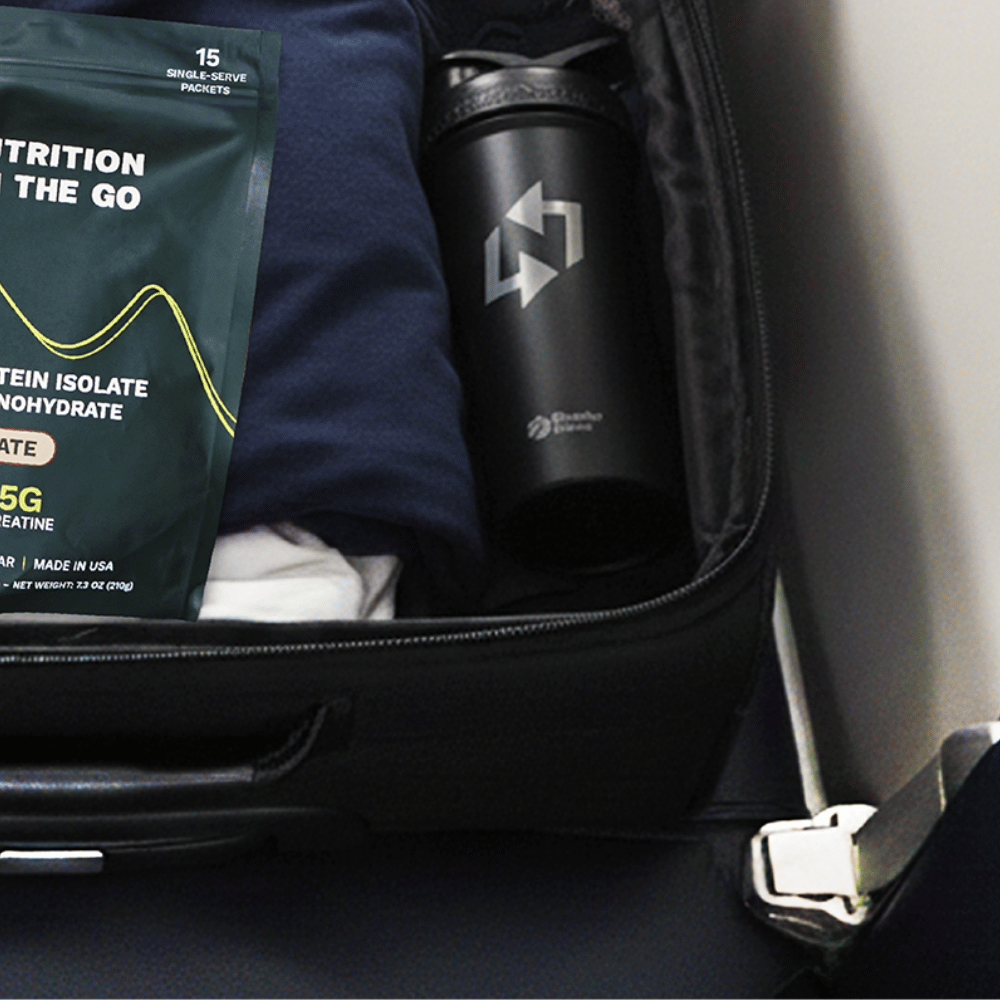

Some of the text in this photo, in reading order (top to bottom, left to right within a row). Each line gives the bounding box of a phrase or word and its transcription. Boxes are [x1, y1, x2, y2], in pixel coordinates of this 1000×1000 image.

[196, 48, 220, 67] 15
[166, 68, 248, 84] SINGLE-SERVE
[180, 82, 231, 96] PACKETS
[13, 173, 80, 205] THE
[90, 181, 142, 211] GO
[56, 373, 149, 398] ISOLATE
[34, 558, 70, 572] MADE
[73, 560, 87, 572] IN
[89, 561, 114, 572] USA
[12, 581, 32, 590] NET
[91, 581, 104, 590] OZ
